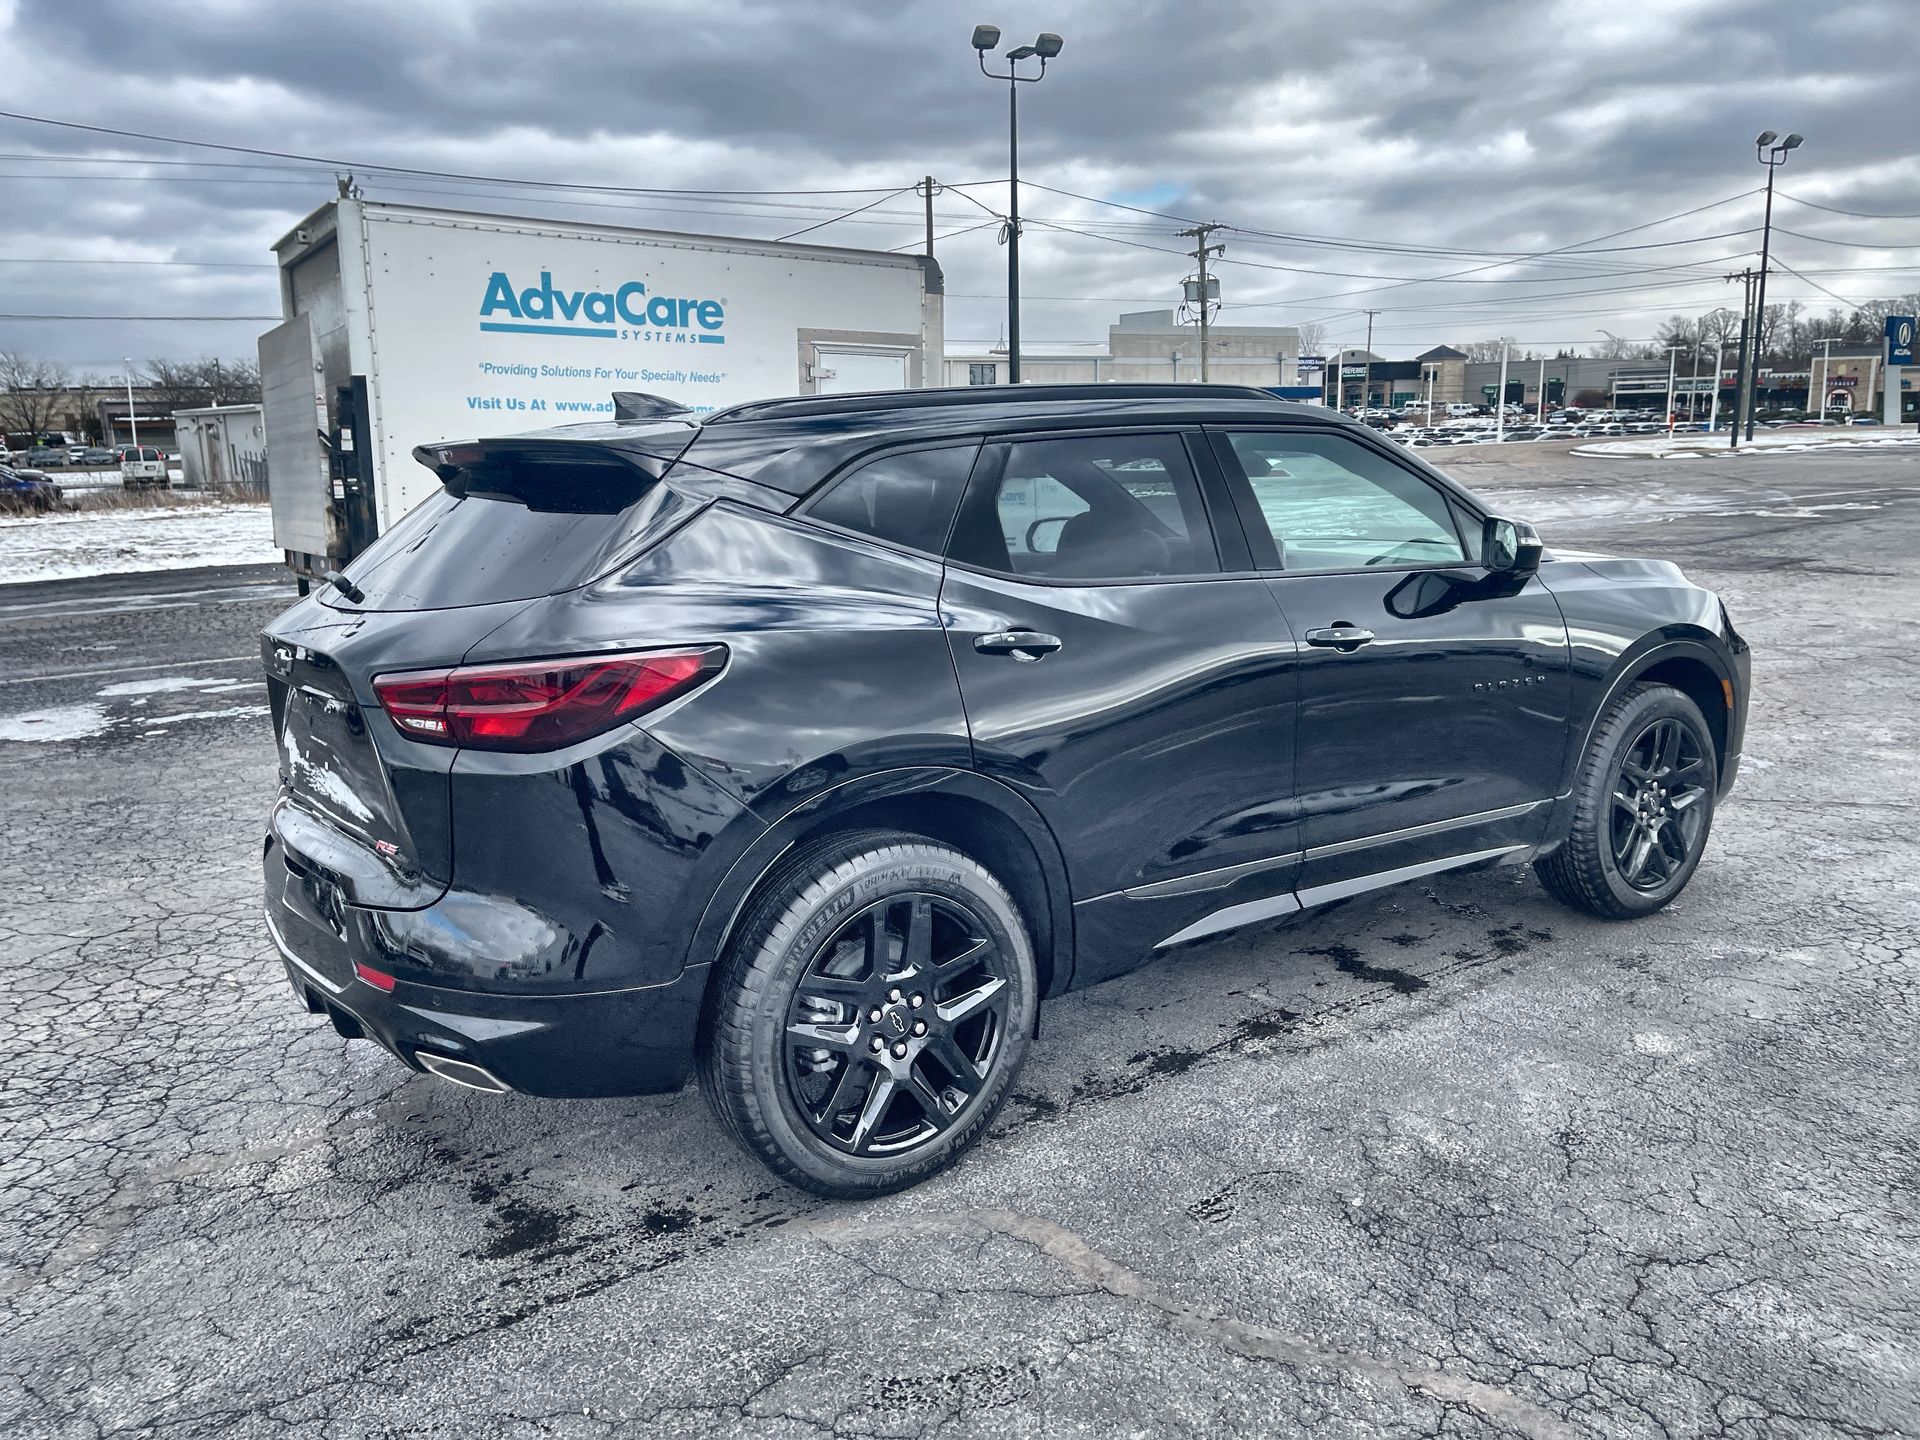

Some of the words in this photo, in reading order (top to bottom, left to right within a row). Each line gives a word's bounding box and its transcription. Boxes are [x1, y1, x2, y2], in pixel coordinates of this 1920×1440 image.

[480, 271, 725, 330] AdvaCare
[621, 329, 698, 344] SYSTEMS
[541, 364, 592, 378] Solutions
[594, 367, 612, 379] For
[615, 368, 639, 379] Your
[641, 369, 687, 383] Specialty
[467, 397, 501, 410] Visit
[506, 398, 526, 410] Us
[530, 399, 546, 411] At
